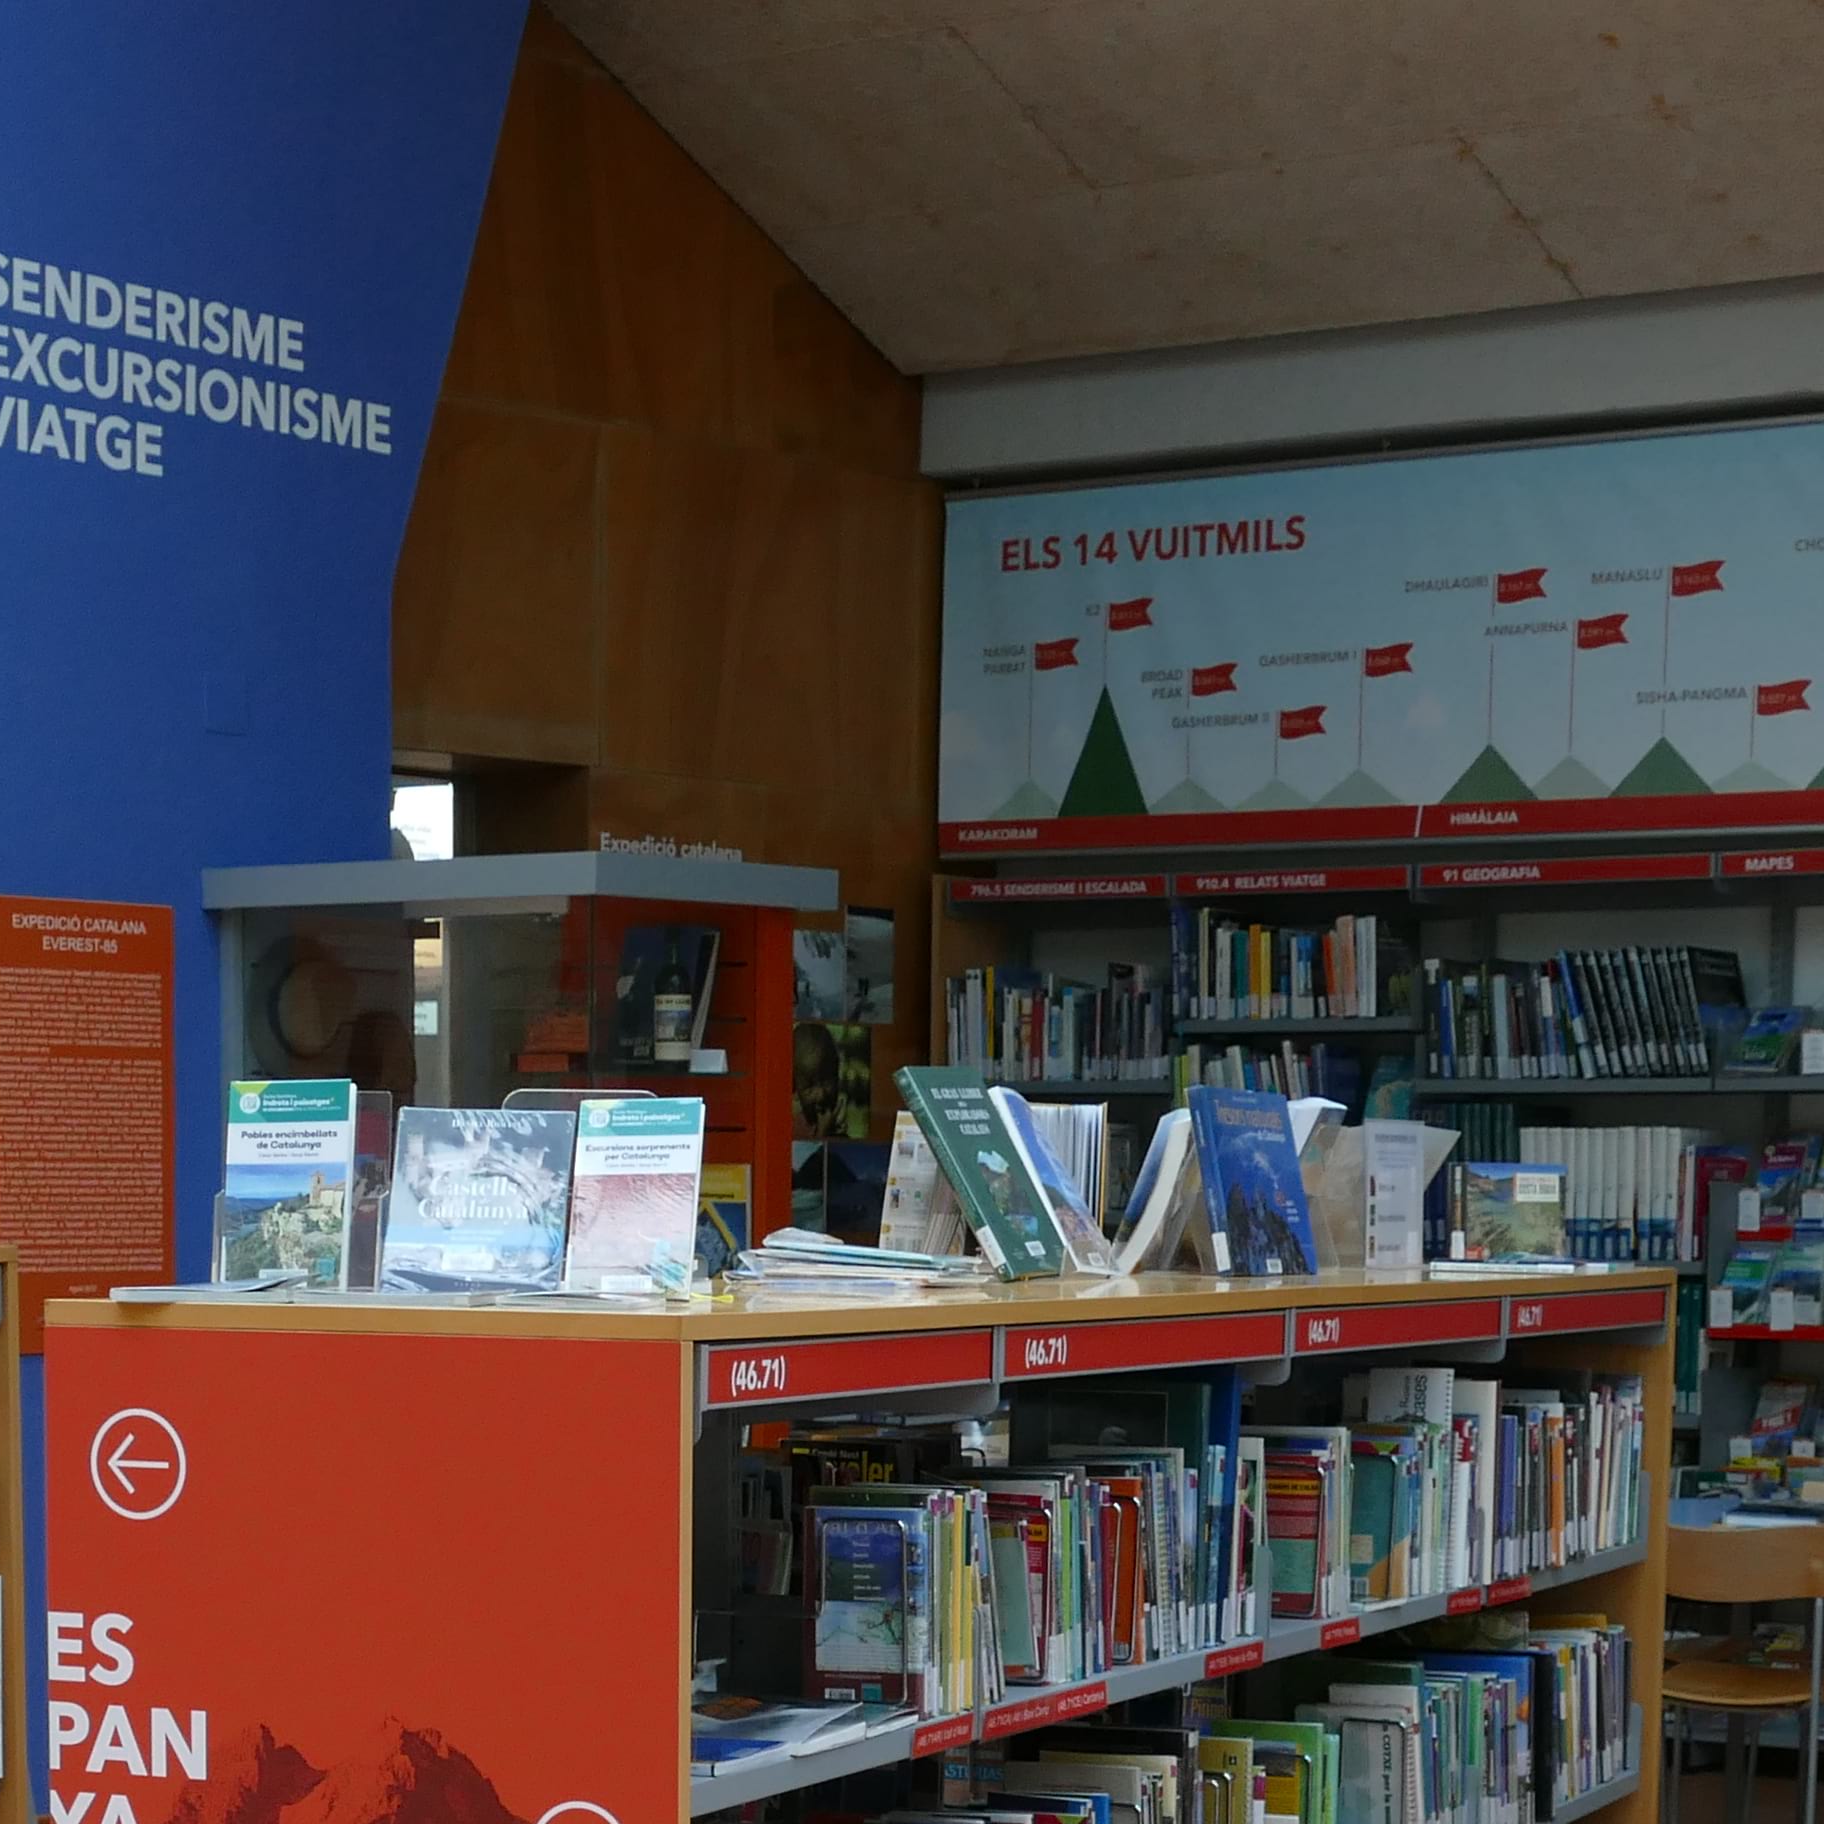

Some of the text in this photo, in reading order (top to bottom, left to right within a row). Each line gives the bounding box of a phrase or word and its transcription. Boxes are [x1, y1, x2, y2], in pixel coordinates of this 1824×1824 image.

[1001, 514, 1308, 573] ELS 14 VUITMILS
[1590, 567, 1663, 585] MANASLU
[1484, 621, 1569, 637] ANNAPURNA
[958, 826, 1038, 843] KARAKORAM
[1443, 865, 1540, 882] 91 GEOGRAFIA
[1744, 854, 1794, 873] MAPES
[1084, 880, 1146, 895] ESCALADA
[1234, 875, 1278, 890] RELATS
[1282, 873, 1326, 889] VIATGE
[11, 912, 147, 936] EXPEDICIÓ CATALANA
[241, 1130, 273, 1139] Pobles
[256, 1140, 322, 1151] de Catalunya
[429, 1175, 518, 1197] Castells
[1515, 1304, 1544, 1329] (46.71)
[1307, 1316, 1340, 1346] (46.71)
[1024, 1333, 1068, 1370] (46.71)
[730, 1356, 786, 1395] (46.71)
[47, 1611, 135, 1688] ES
[48, 1703, 209, 1782] PAN
